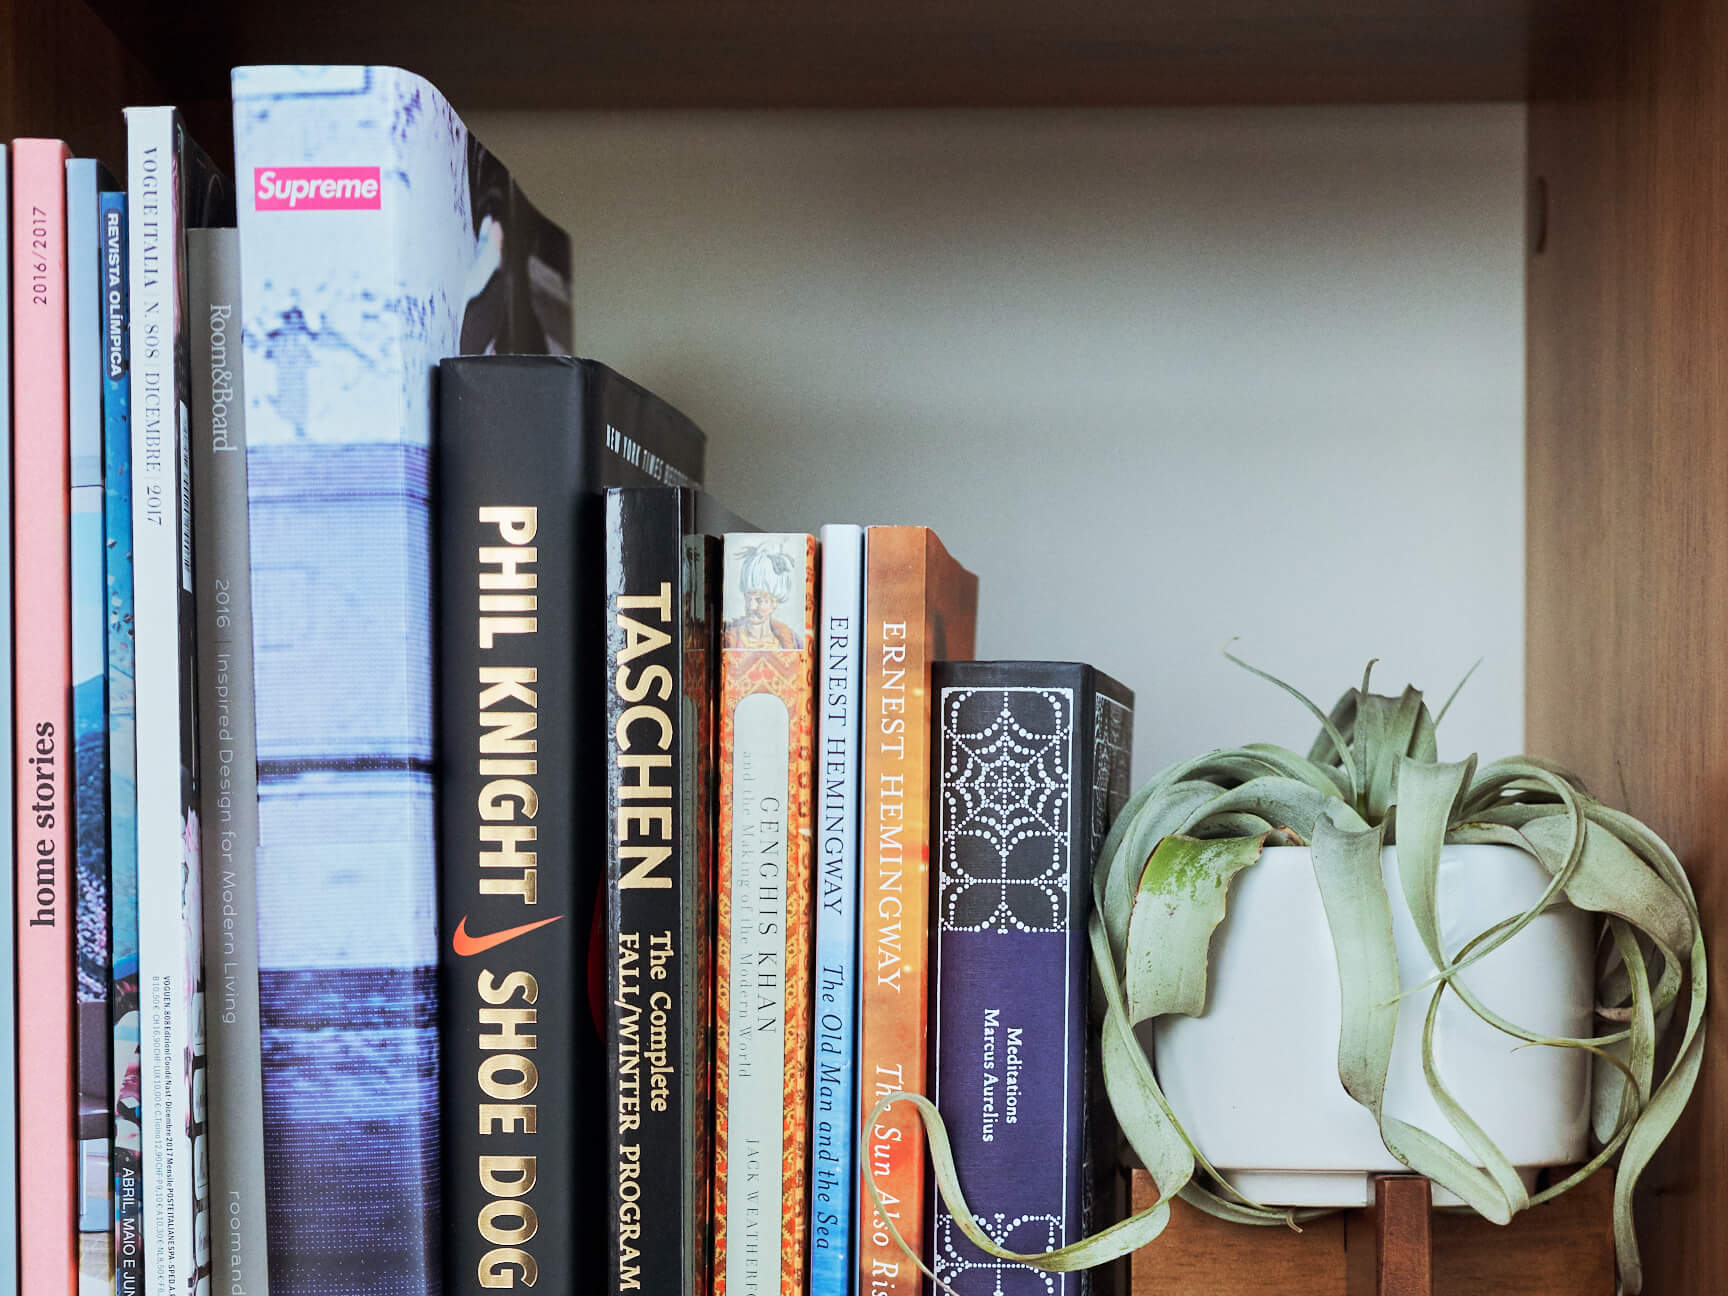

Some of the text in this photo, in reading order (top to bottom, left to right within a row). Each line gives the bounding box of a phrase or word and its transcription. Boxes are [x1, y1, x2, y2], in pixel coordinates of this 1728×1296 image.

[33, 206, 47, 304] 2016/2017
[258, 171, 378, 208] Supreme
[107, 213, 125, 378] REVISTA OLÍMPICA
[143, 148, 161, 526] VOGUE ITALIA N. 808 DICEMBRE 2017
[208, 302, 239, 455] Room&Board
[615, 581, 673, 891] TASCHEN
[881, 619, 908, 760] ERNEST
[29, 722, 55, 927] home stories
[212, 578, 241, 1026] 2016 Inspired Design for Modern Living
[878, 773, 903, 992] HEMINGWAY
[478, 506, 538, 1288] PHIL KNIGHT SHOE DOG
[737, 752, 755, 1076] and the Making of the Modern World
[758, 798, 779, 1031] GENGHIS KHAN
[817, 616, 848, 1248] ERNEST HEMINGWAY The Old Man and the Sea
[644, 930, 674, 1111] The Complete
[983, 1009, 1000, 1142] Marcus Aurelius
[1006, 1028, 1022, 1123] Meditations
[119, 1168, 134, 1215] ABRIL,
[614, 931, 642, 1291] FALL/WINTER PROGRAM
[746, 1139, 759, 1181] JACK
[871, 1123, 901, 1179] Sun
[123, 1218, 136, 1256] MAIO
[124, 1260, 135, 1268] E
